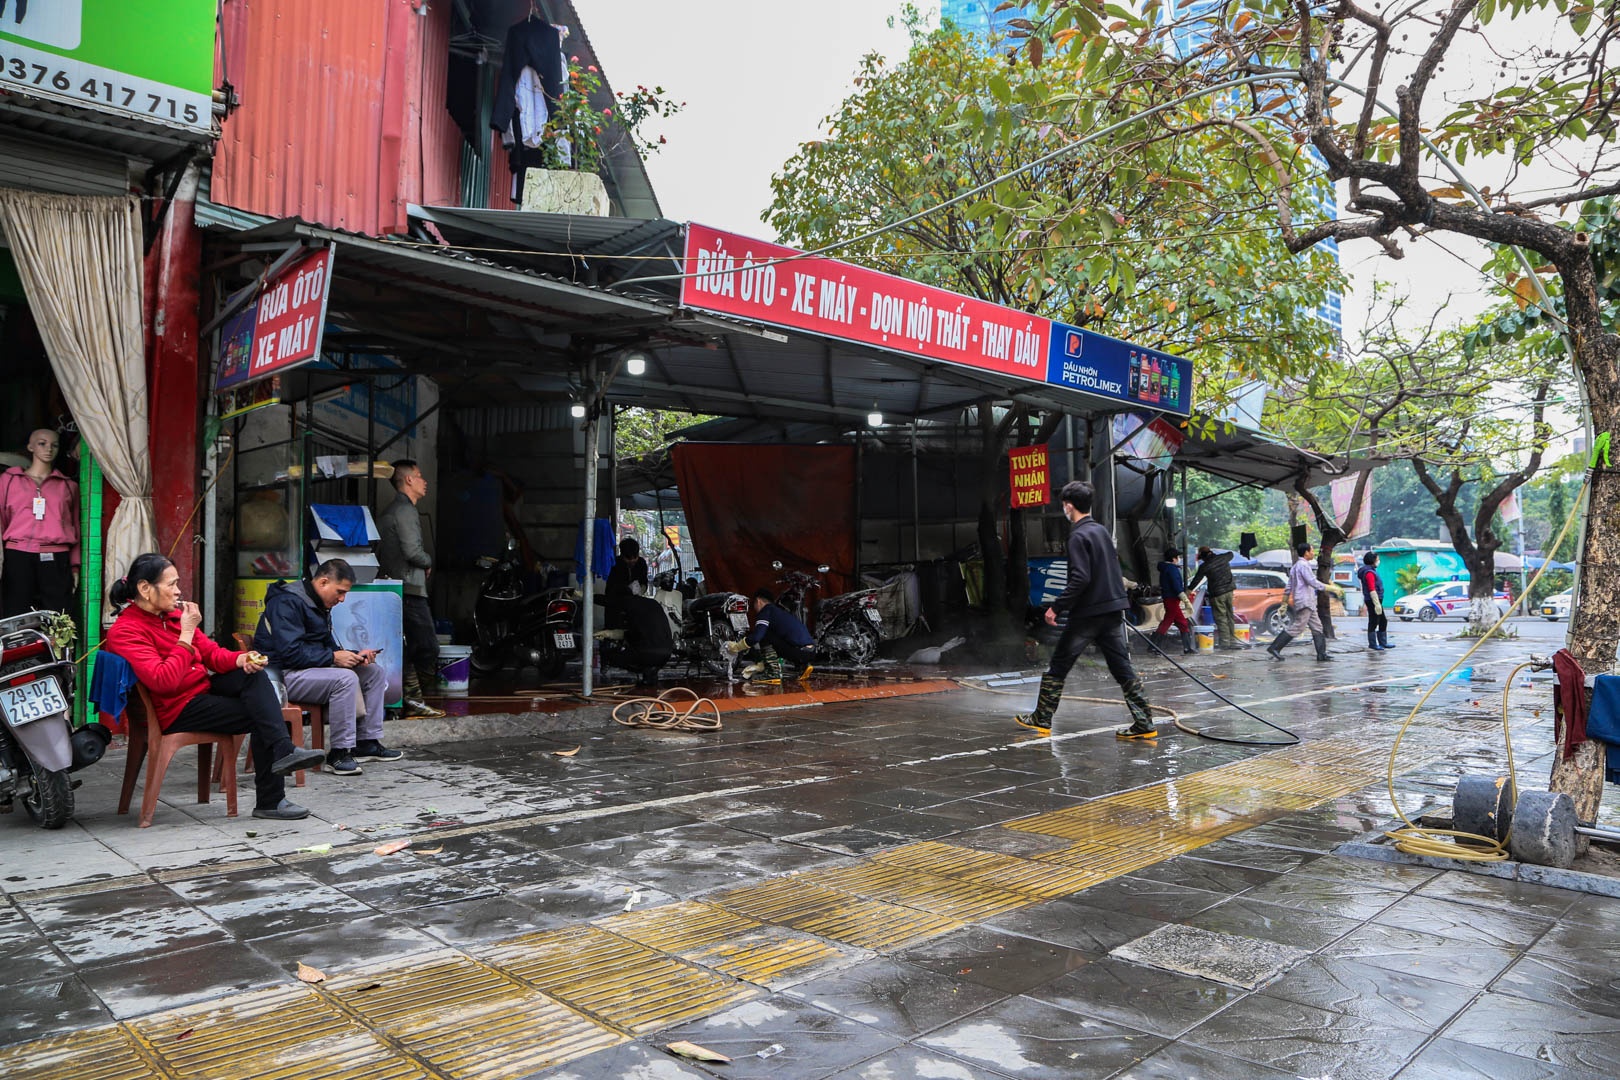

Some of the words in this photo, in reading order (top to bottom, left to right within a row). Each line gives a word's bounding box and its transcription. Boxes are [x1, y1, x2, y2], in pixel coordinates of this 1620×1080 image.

[0, 54, 70, 91] 376
[80, 78, 136, 107] 417
[147, 93, 199, 123] 715
[292, 260, 323, 310] ÔTÔ
[696, 238, 735, 298] RỬA
[740, 250, 776, 306] ÔTÔ
[791, 272, 816, 316] XE
[818, 275, 857, 325] MÁY
[870, 292, 904, 342] DỌN
[906, 297, 933, 350] NỘI
[936, 302, 971, 351] THẤT
[982, 320, 1013, 361] THAY
[1014, 320, 1041, 368] DẦU
[255, 332, 276, 369] XE
[277, 314, 315, 360] MÁY
[1062, 371, 1122, 395] PETROLIMEX
[1014, 470, 1045, 488] NHÂN
[8, 681, 51, 706] 29-D2
[10, 695, 62, 724] 245.65
